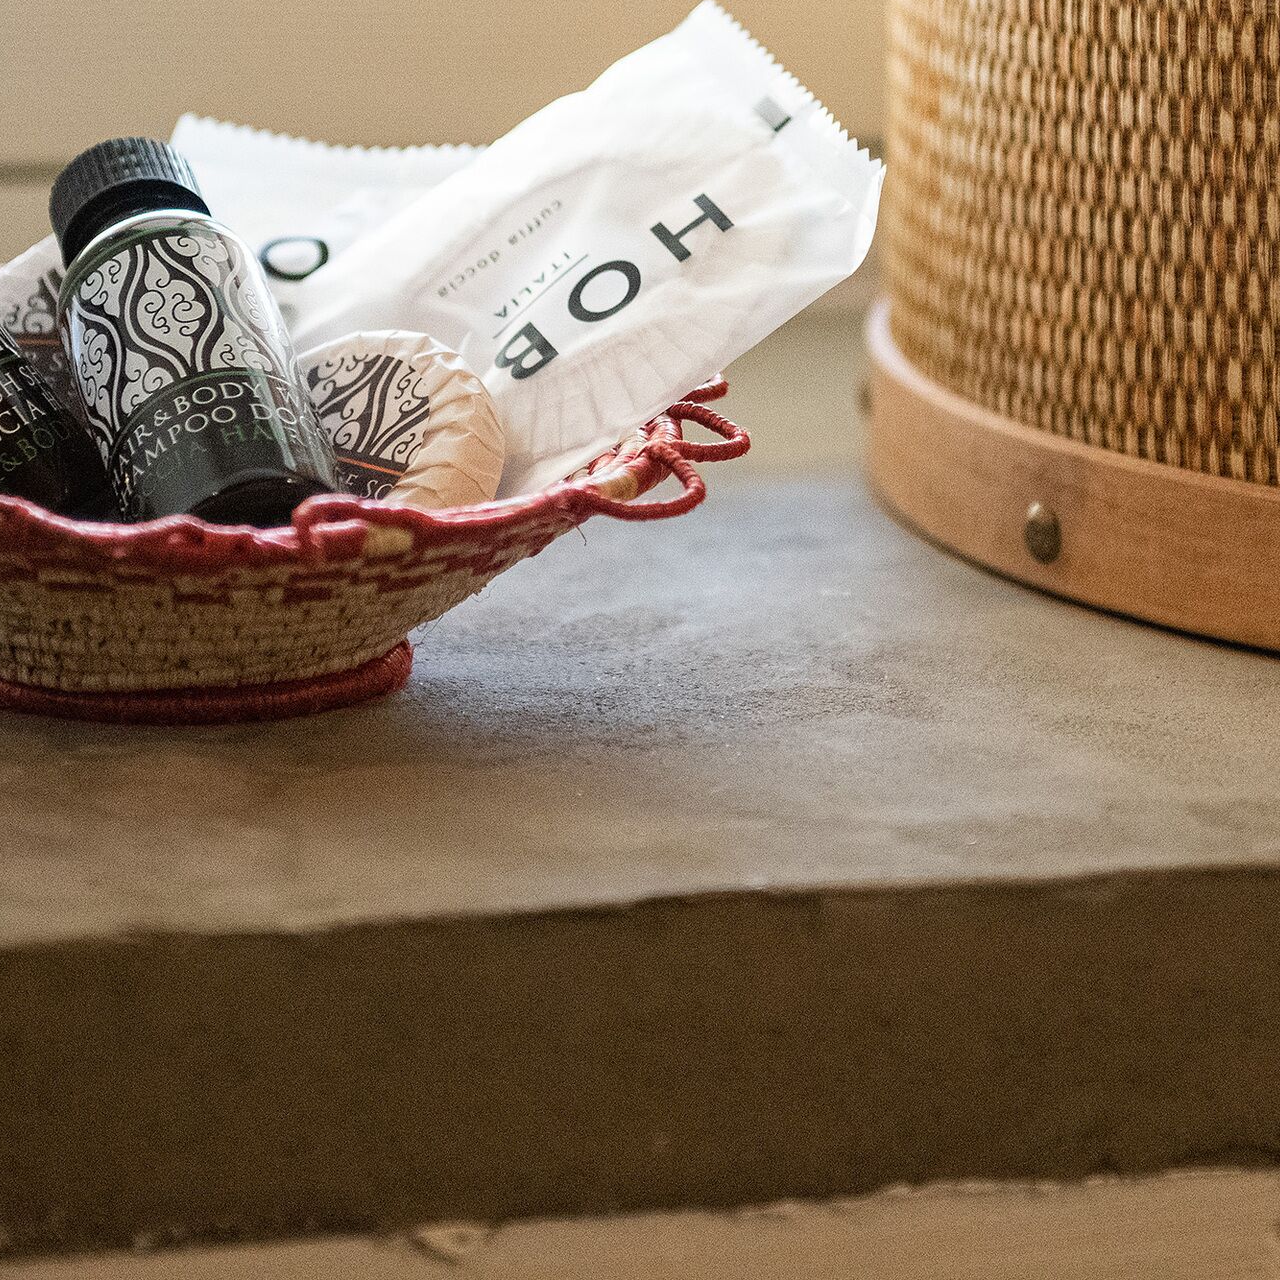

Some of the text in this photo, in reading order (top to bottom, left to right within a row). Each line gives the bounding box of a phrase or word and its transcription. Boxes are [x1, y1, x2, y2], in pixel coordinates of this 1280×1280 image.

[436, 249, 500, 298] doccia
[493, 251, 571, 319] ITALIA
[153, 408, 172, 427] &
[172, 381, 262, 416] BODY
